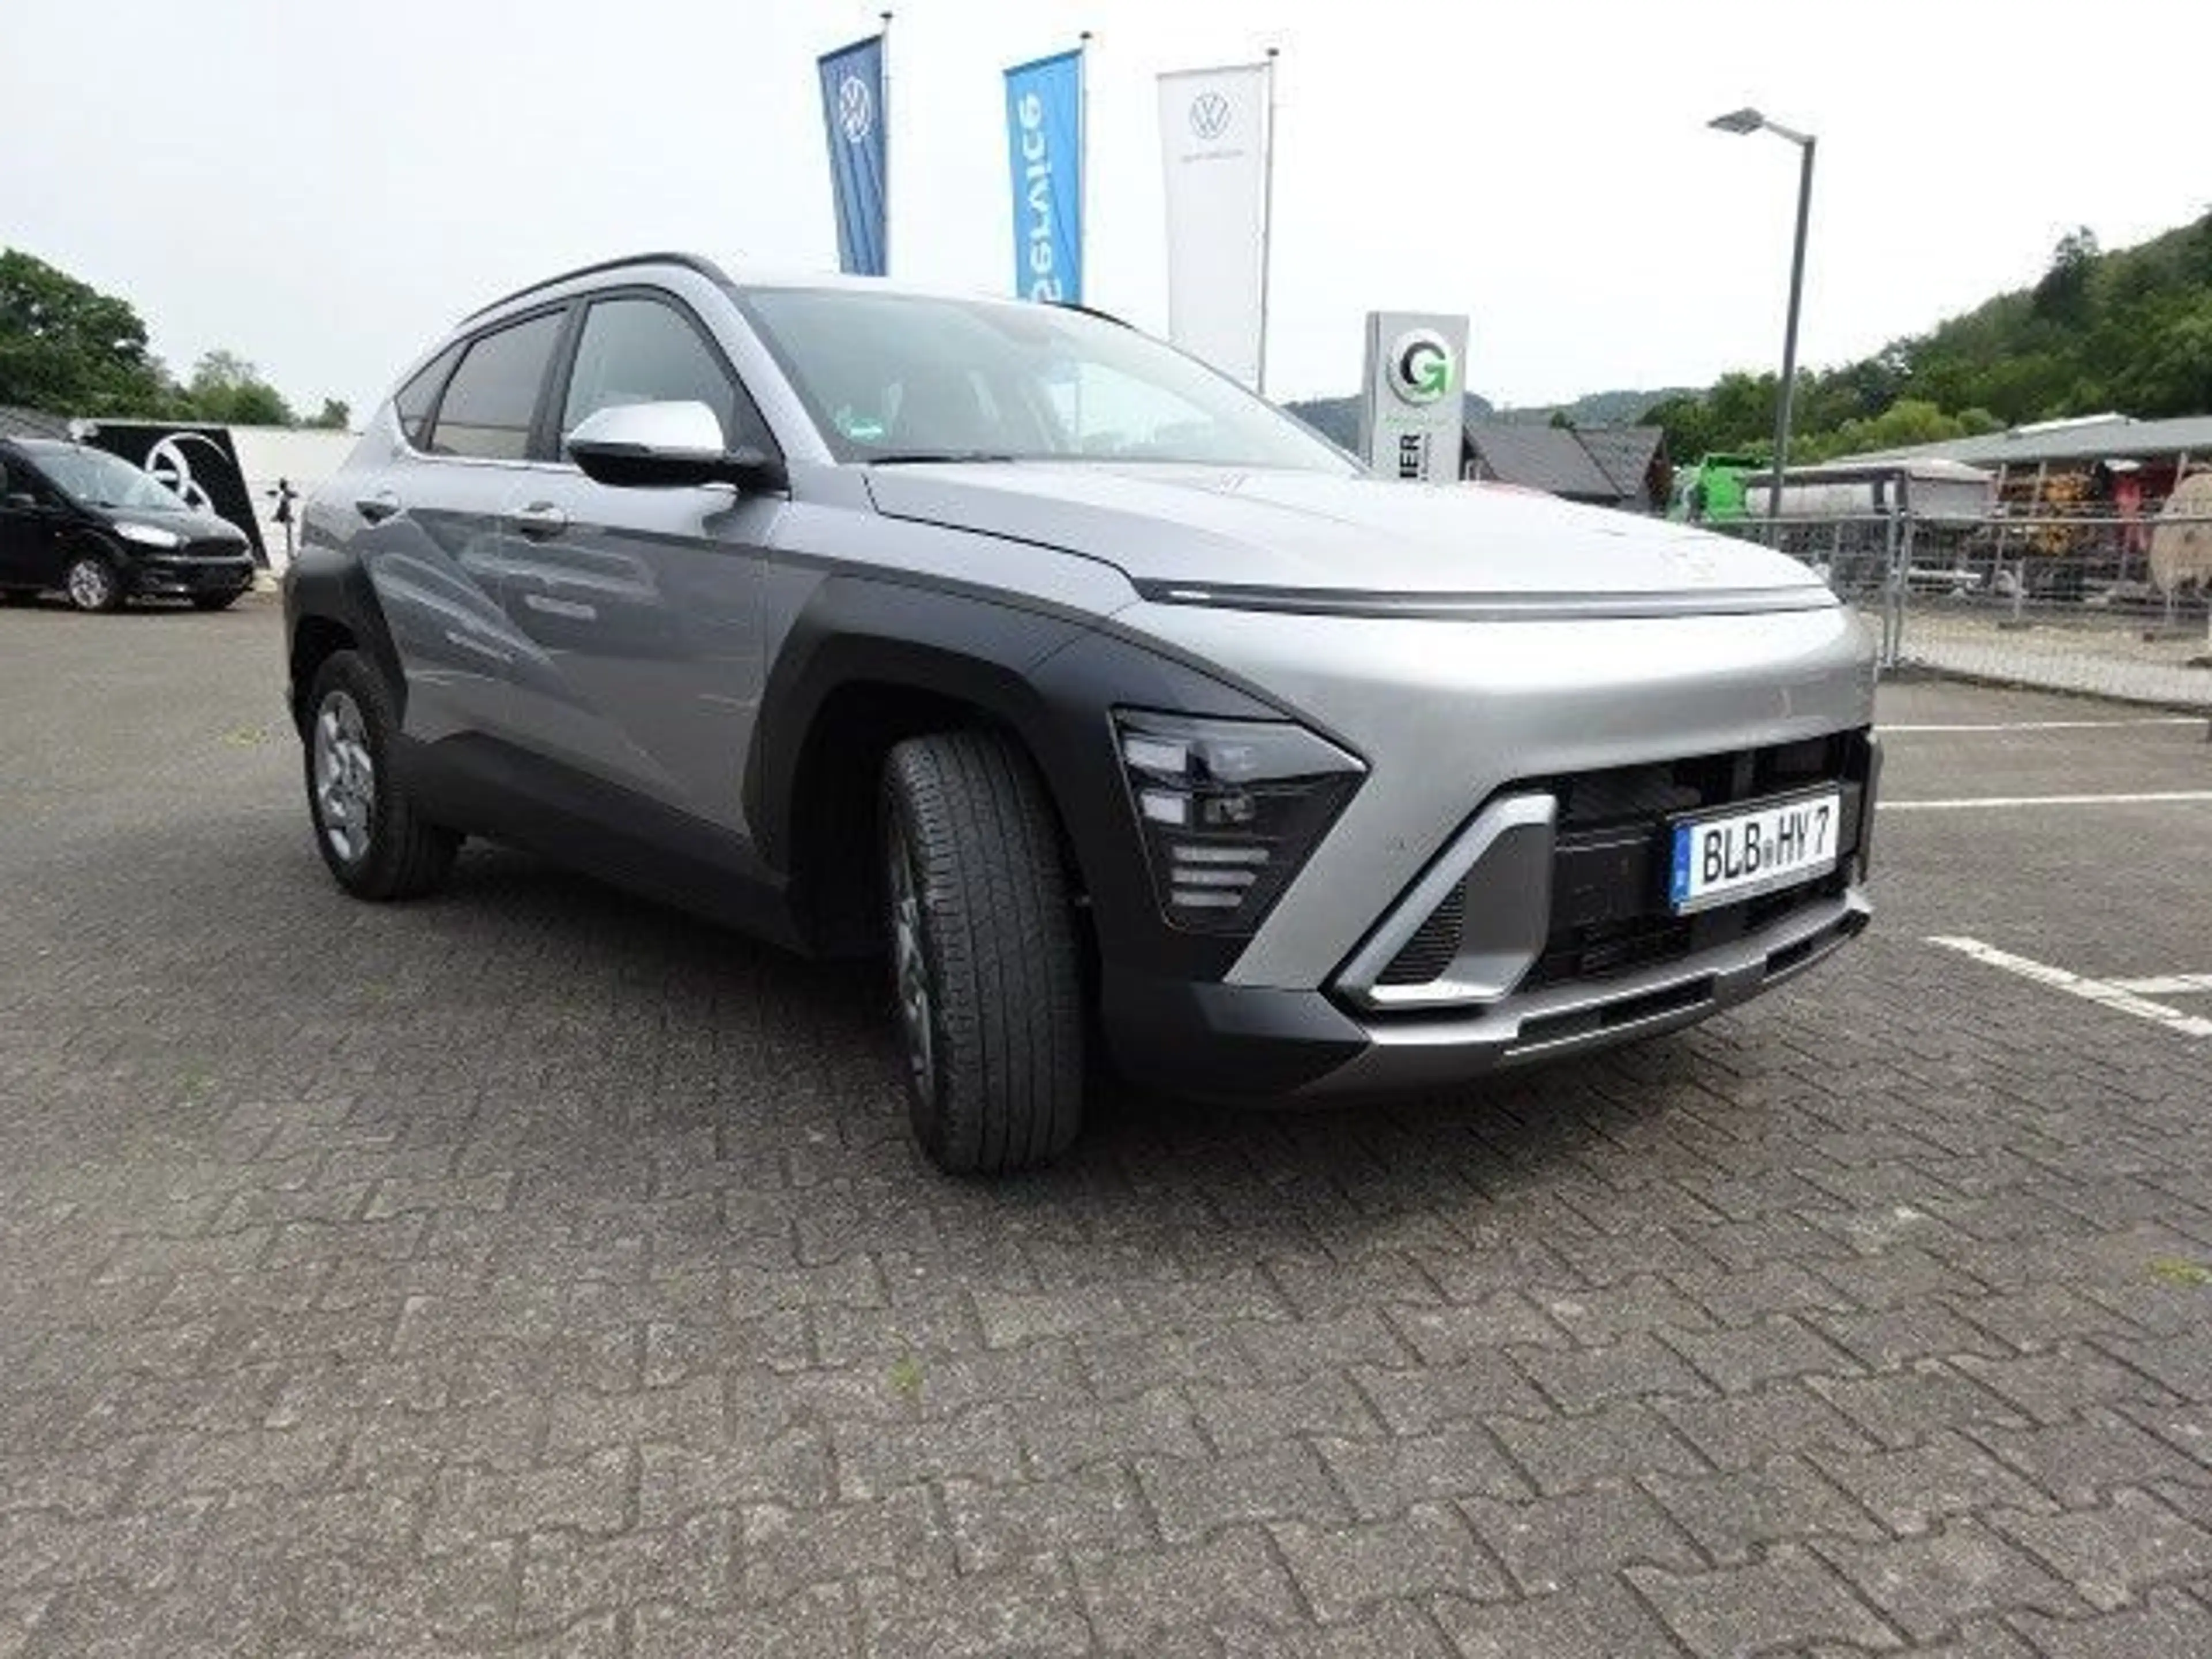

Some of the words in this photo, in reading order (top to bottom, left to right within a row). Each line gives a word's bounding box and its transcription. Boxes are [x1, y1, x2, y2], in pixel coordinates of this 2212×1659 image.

[1703, 821, 1760, 884] BLB
[1777, 812, 1809, 865] HY
[1817, 805, 1829, 854] 7
